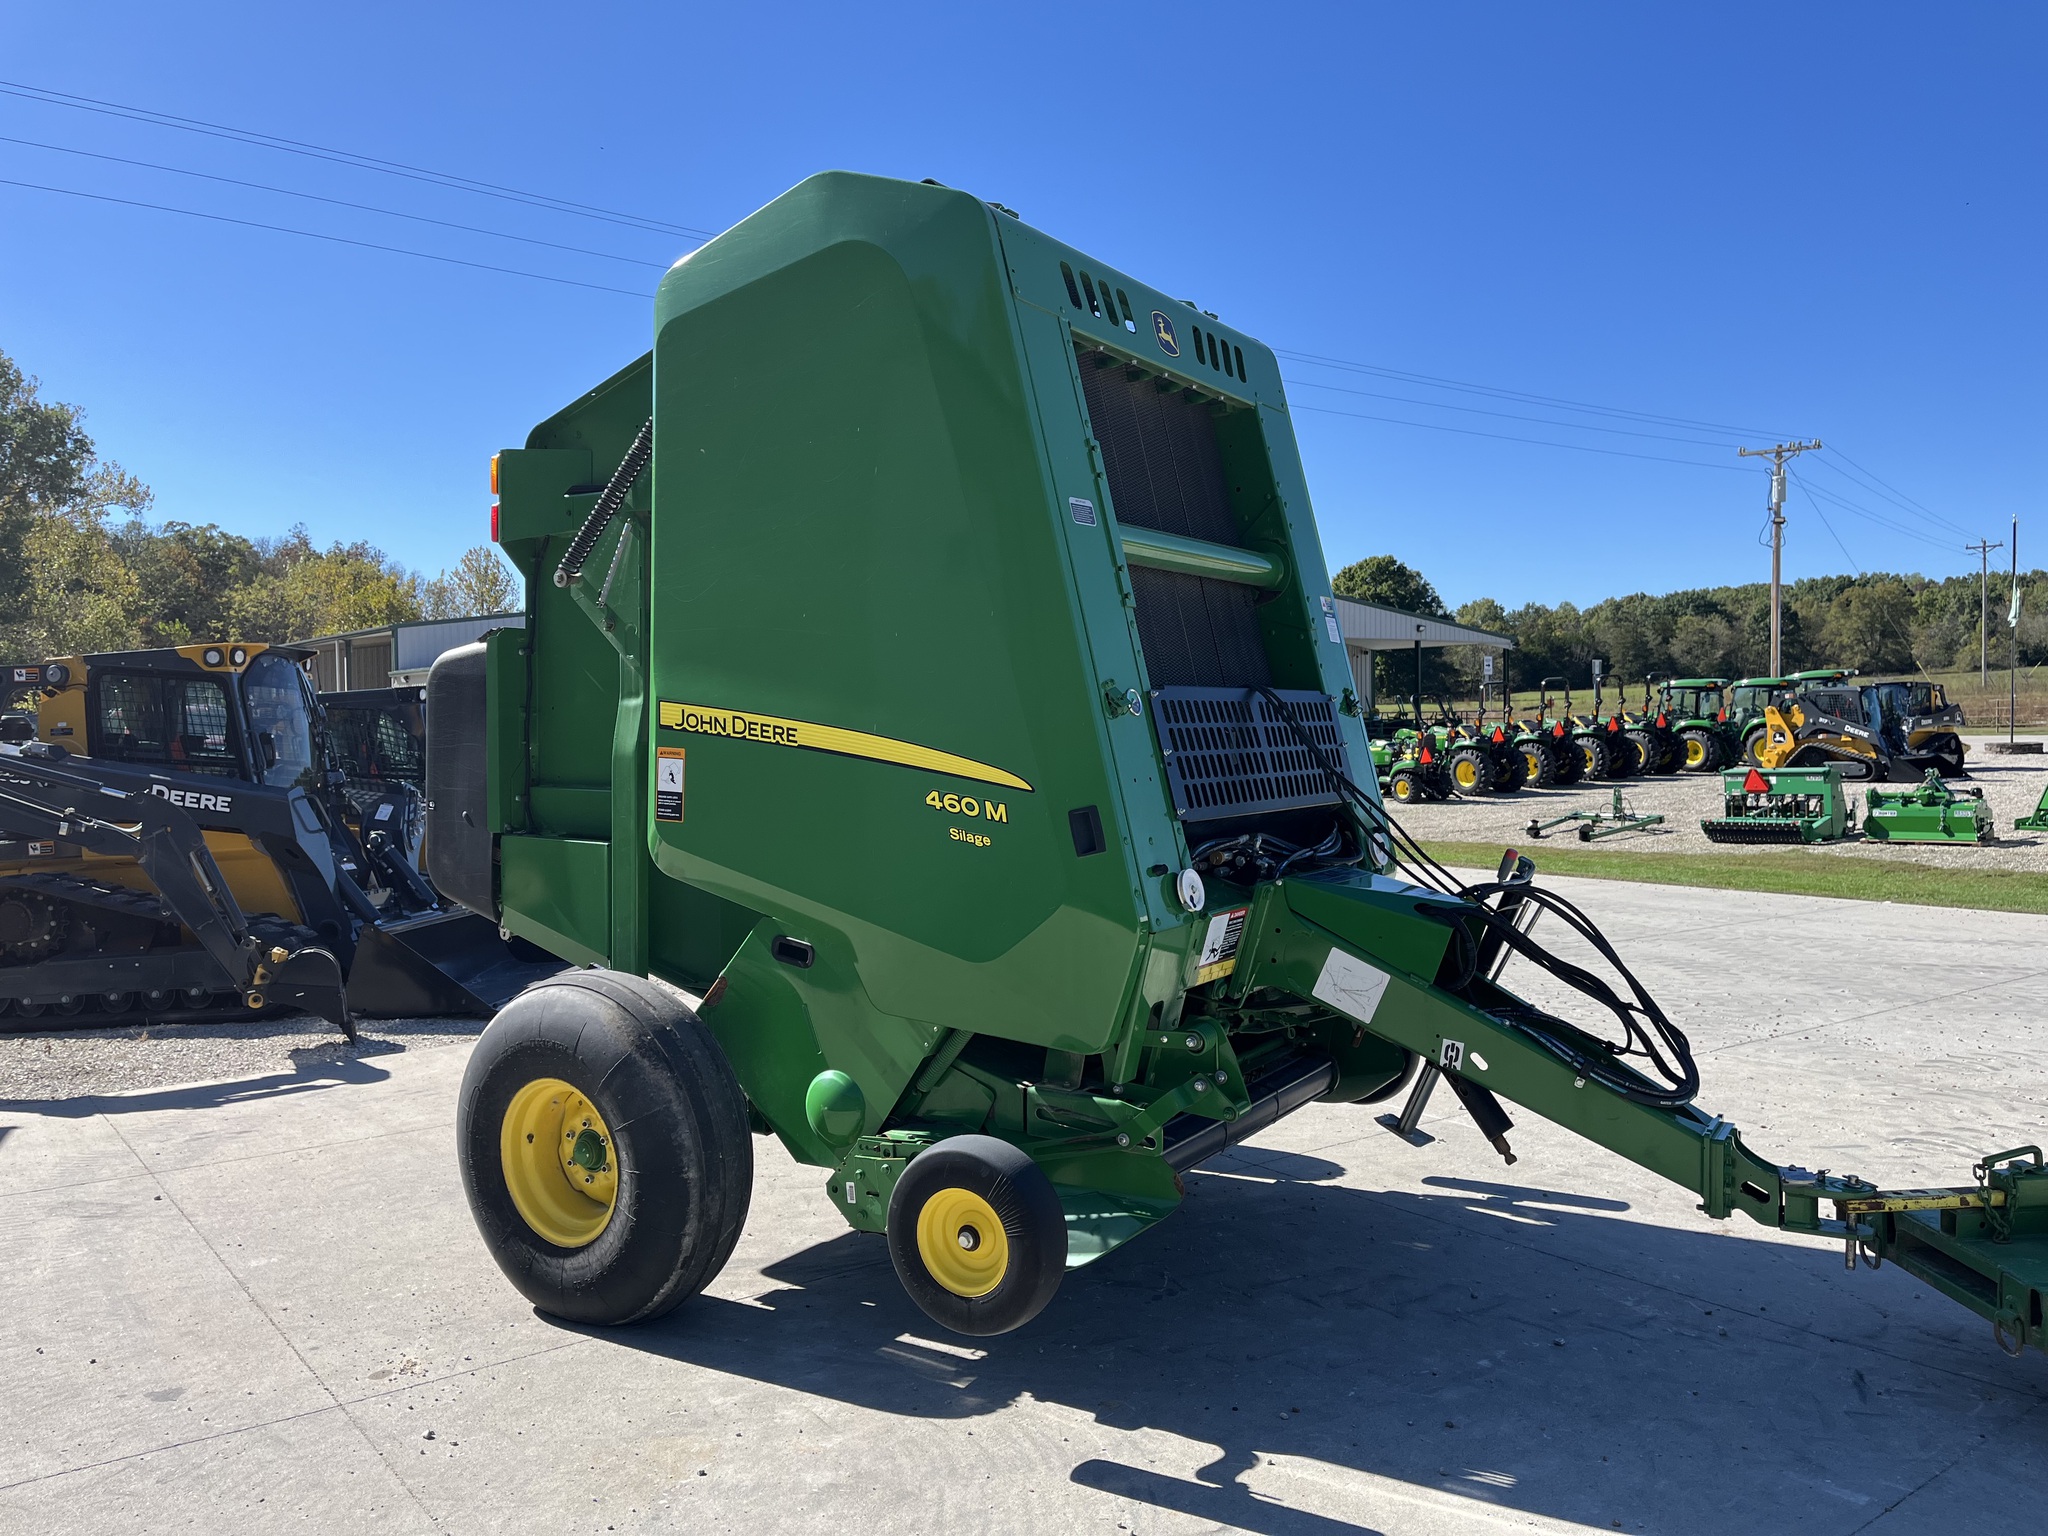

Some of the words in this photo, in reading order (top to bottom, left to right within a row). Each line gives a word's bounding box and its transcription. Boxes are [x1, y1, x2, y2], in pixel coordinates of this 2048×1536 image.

[674, 708, 727, 733] JOHN
[731, 715, 798, 744] DEERE
[1843, 724, 1870, 739] DEERE
[151, 784, 232, 813] DEERE
[925, 789, 980, 818] 460
[984, 800, 1008, 824] M
[949, 827, 991, 847] Silage
